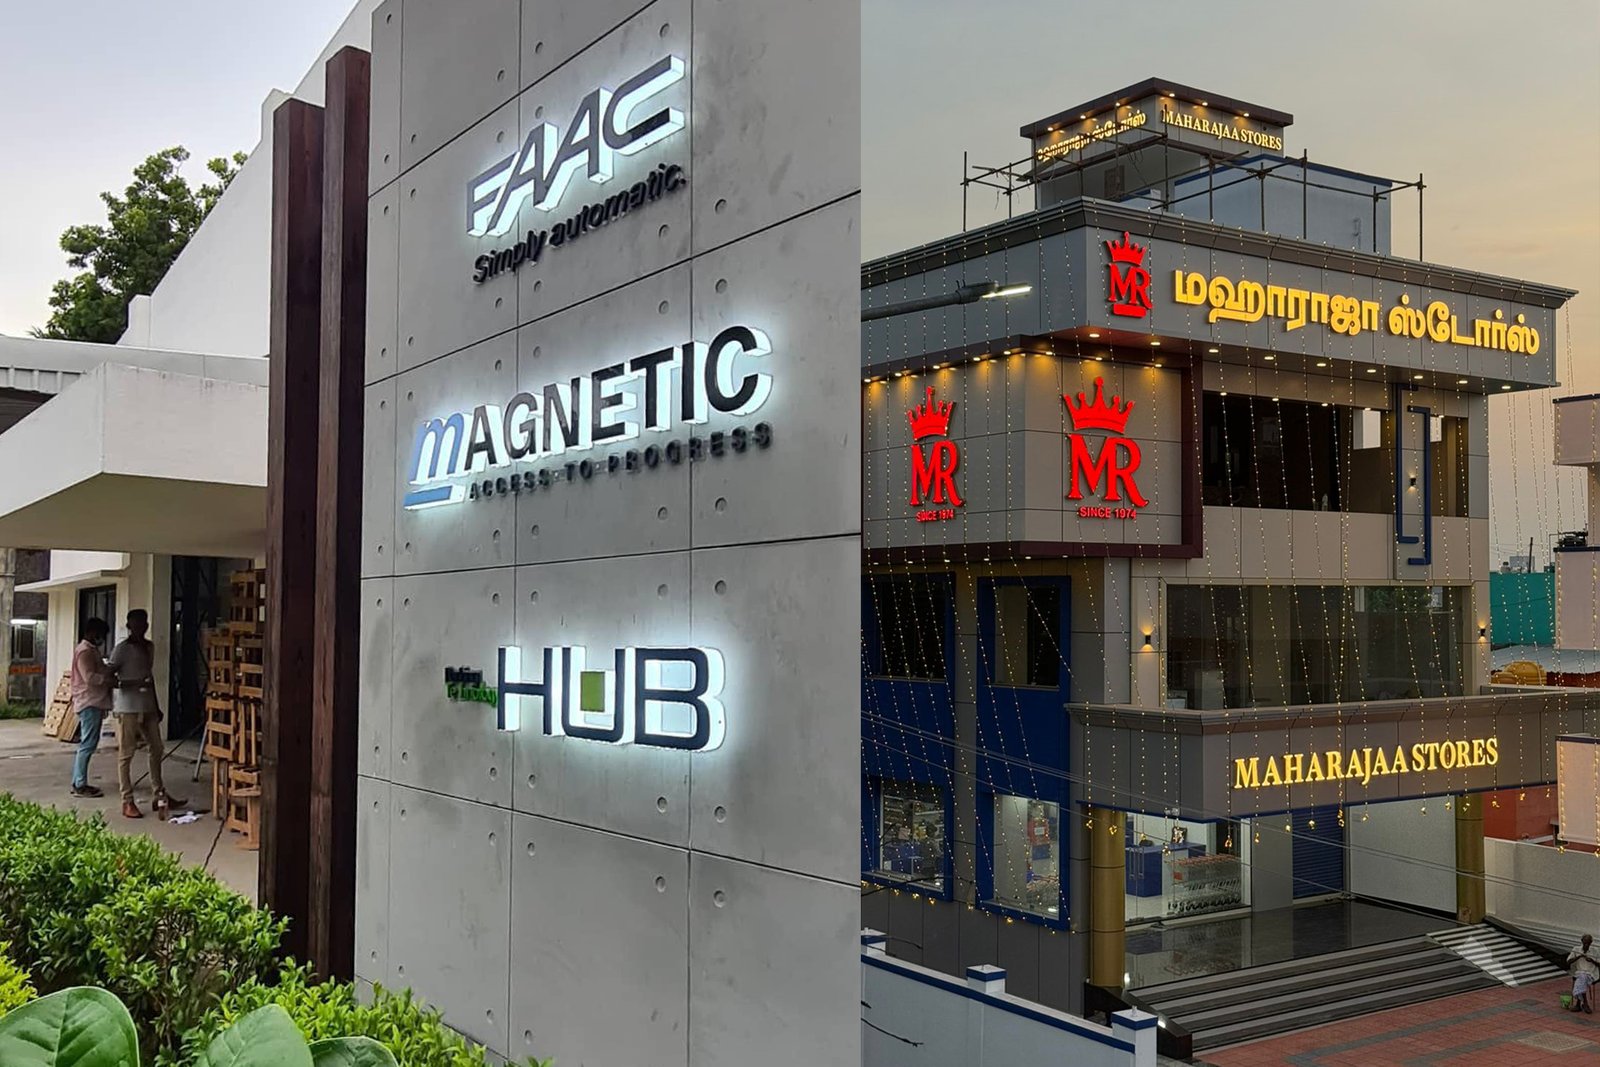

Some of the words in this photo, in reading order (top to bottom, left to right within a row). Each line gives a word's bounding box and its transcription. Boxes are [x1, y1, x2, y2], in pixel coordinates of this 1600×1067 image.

[466, 54, 685, 237] FAAC
[1161, 108, 1240, 140] MAHARAJAA
[1240, 128, 1282, 151] STORES
[1174, 269, 1380, 336] மஹாராஜா
[1388, 294, 1541, 355] ஸ்டோர்ஸ்
[469, 467, 552, 501] ACCESS
[564, 458, 594, 481] TO
[608, 421, 773, 474] PROGRESS
[1079, 506, 1111, 519] SINCE
[1114, 507, 1137, 520] 1974
[497, 646, 726, 752] HUB
[1233, 746, 1409, 789] MAHARAJAA
[1411, 738, 1498, 772] STORES
